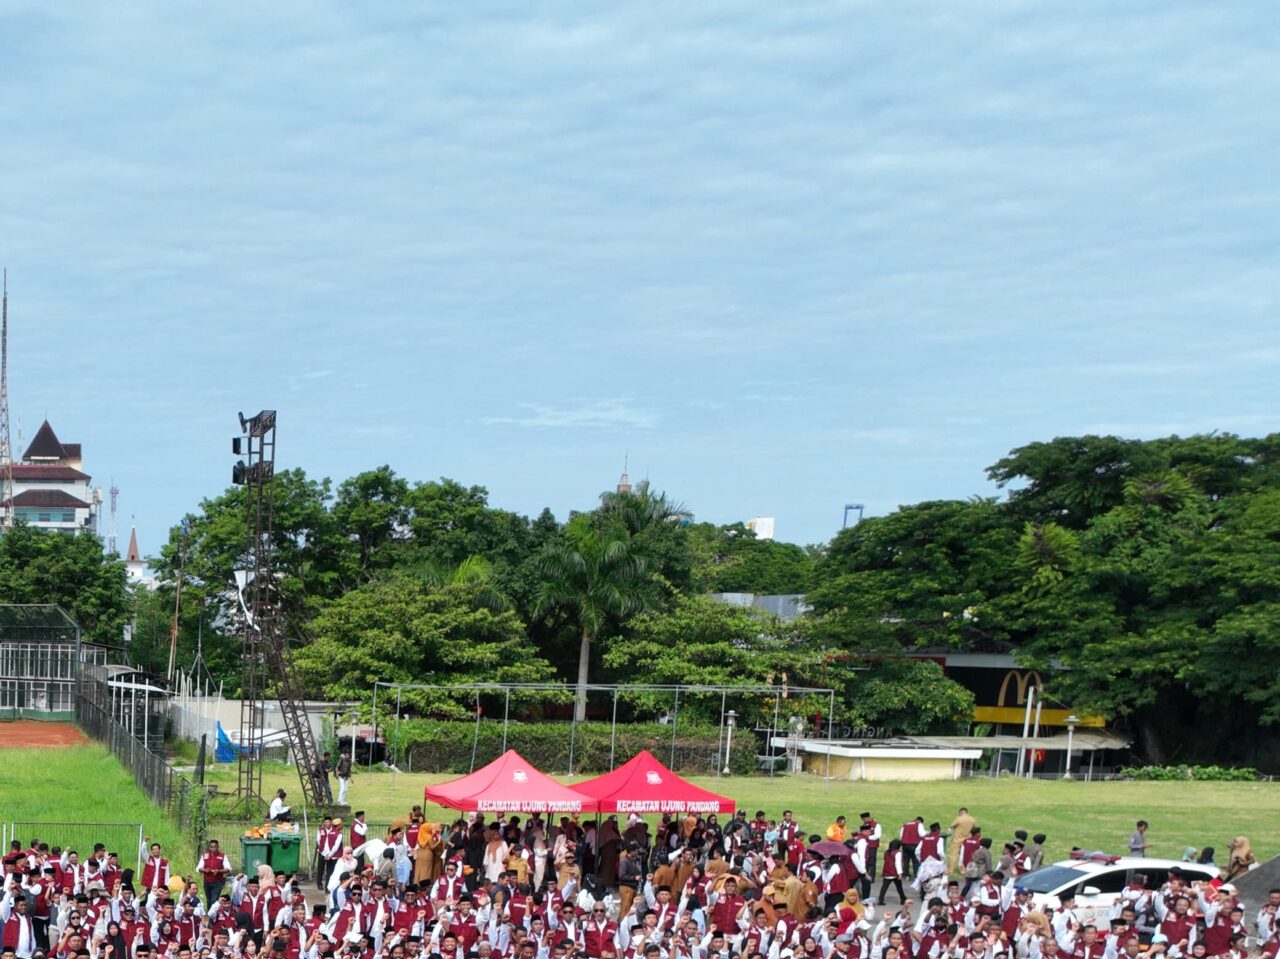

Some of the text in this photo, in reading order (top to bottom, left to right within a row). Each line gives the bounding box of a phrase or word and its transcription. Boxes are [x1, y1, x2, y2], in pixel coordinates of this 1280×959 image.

[477, 800, 582, 812] KECAMATAN UJUNG PANDANG
[616, 800, 720, 812] KECAMATAN UJUNG PANDANG
